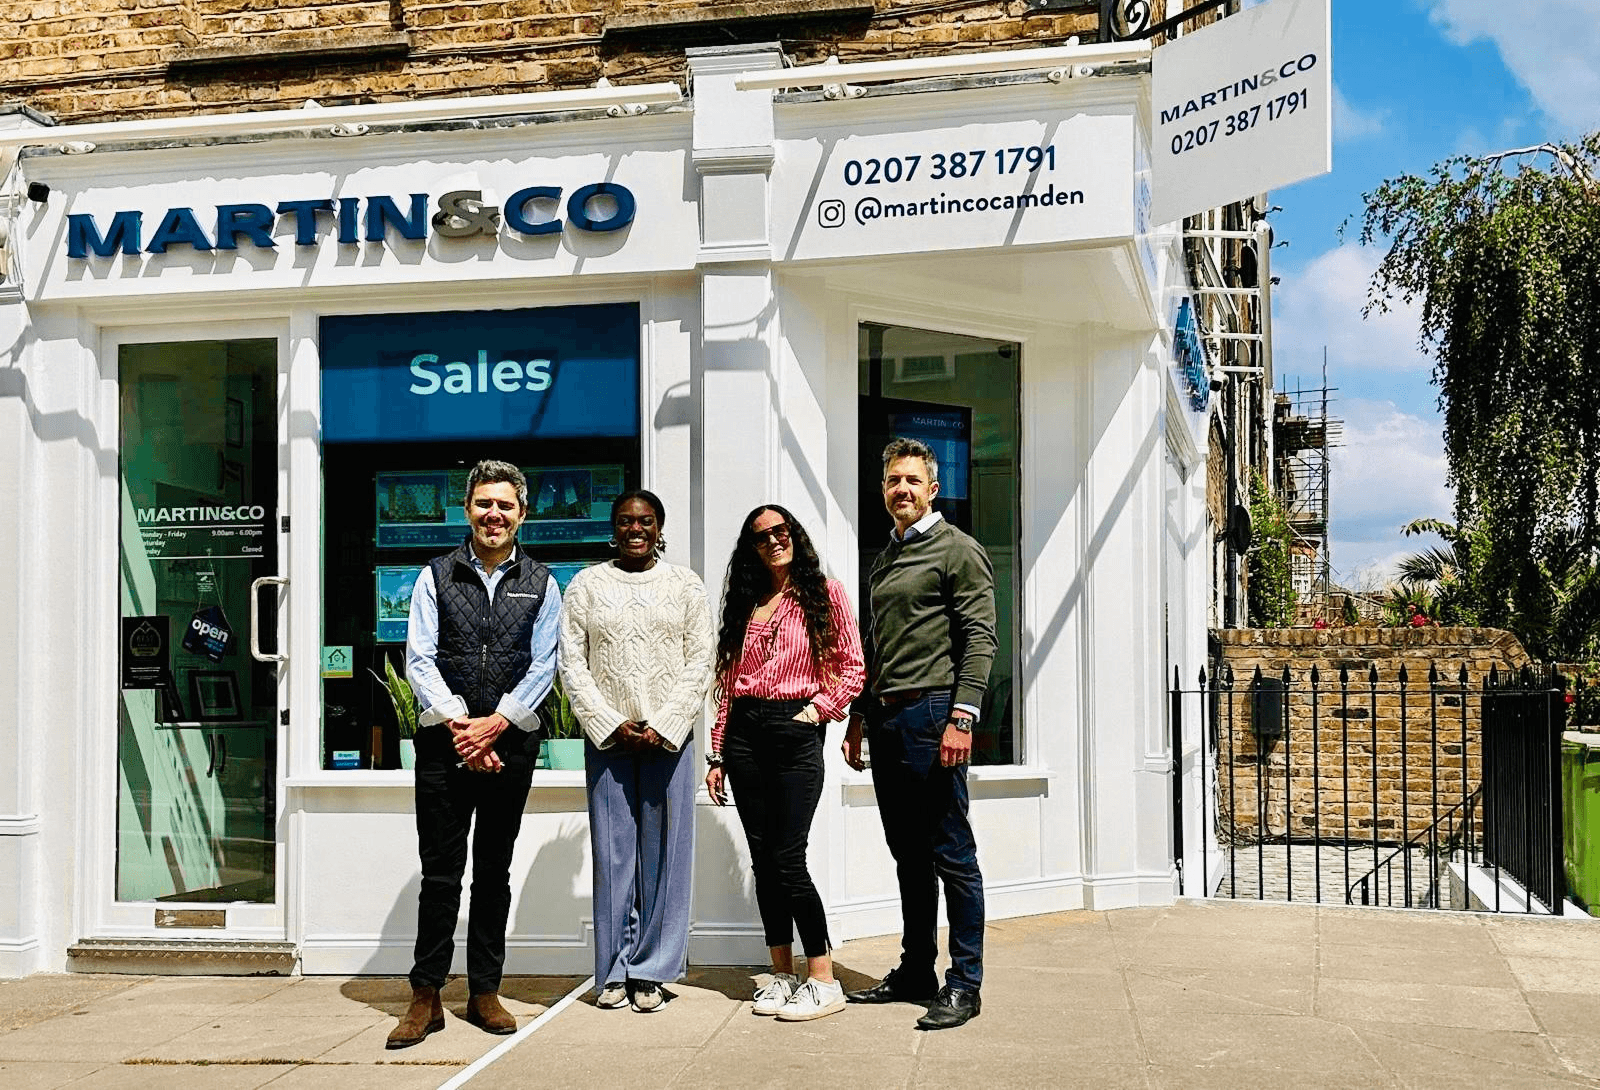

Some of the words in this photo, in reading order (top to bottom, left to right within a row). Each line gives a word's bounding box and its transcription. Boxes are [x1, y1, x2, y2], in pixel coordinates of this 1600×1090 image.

[1160, 53, 1317, 125] MARTIN&CO
[1171, 120, 1219, 156] 0207
[1224, 106, 1261, 137] 387
[1267, 88, 1308, 123] 1791
[844, 154, 921, 185] 0207
[930, 150, 986, 178] 387
[995, 145, 1056, 175] 1791
[66, 182, 637, 258] MARTIN&CO
[855, 185, 1084, 226] @martincocamden
[409, 349, 553, 396] Sales
[136, 505, 265, 522] MARTIN&CO
[168, 530, 187, 539] Friday
[191, 618, 229, 643] open
